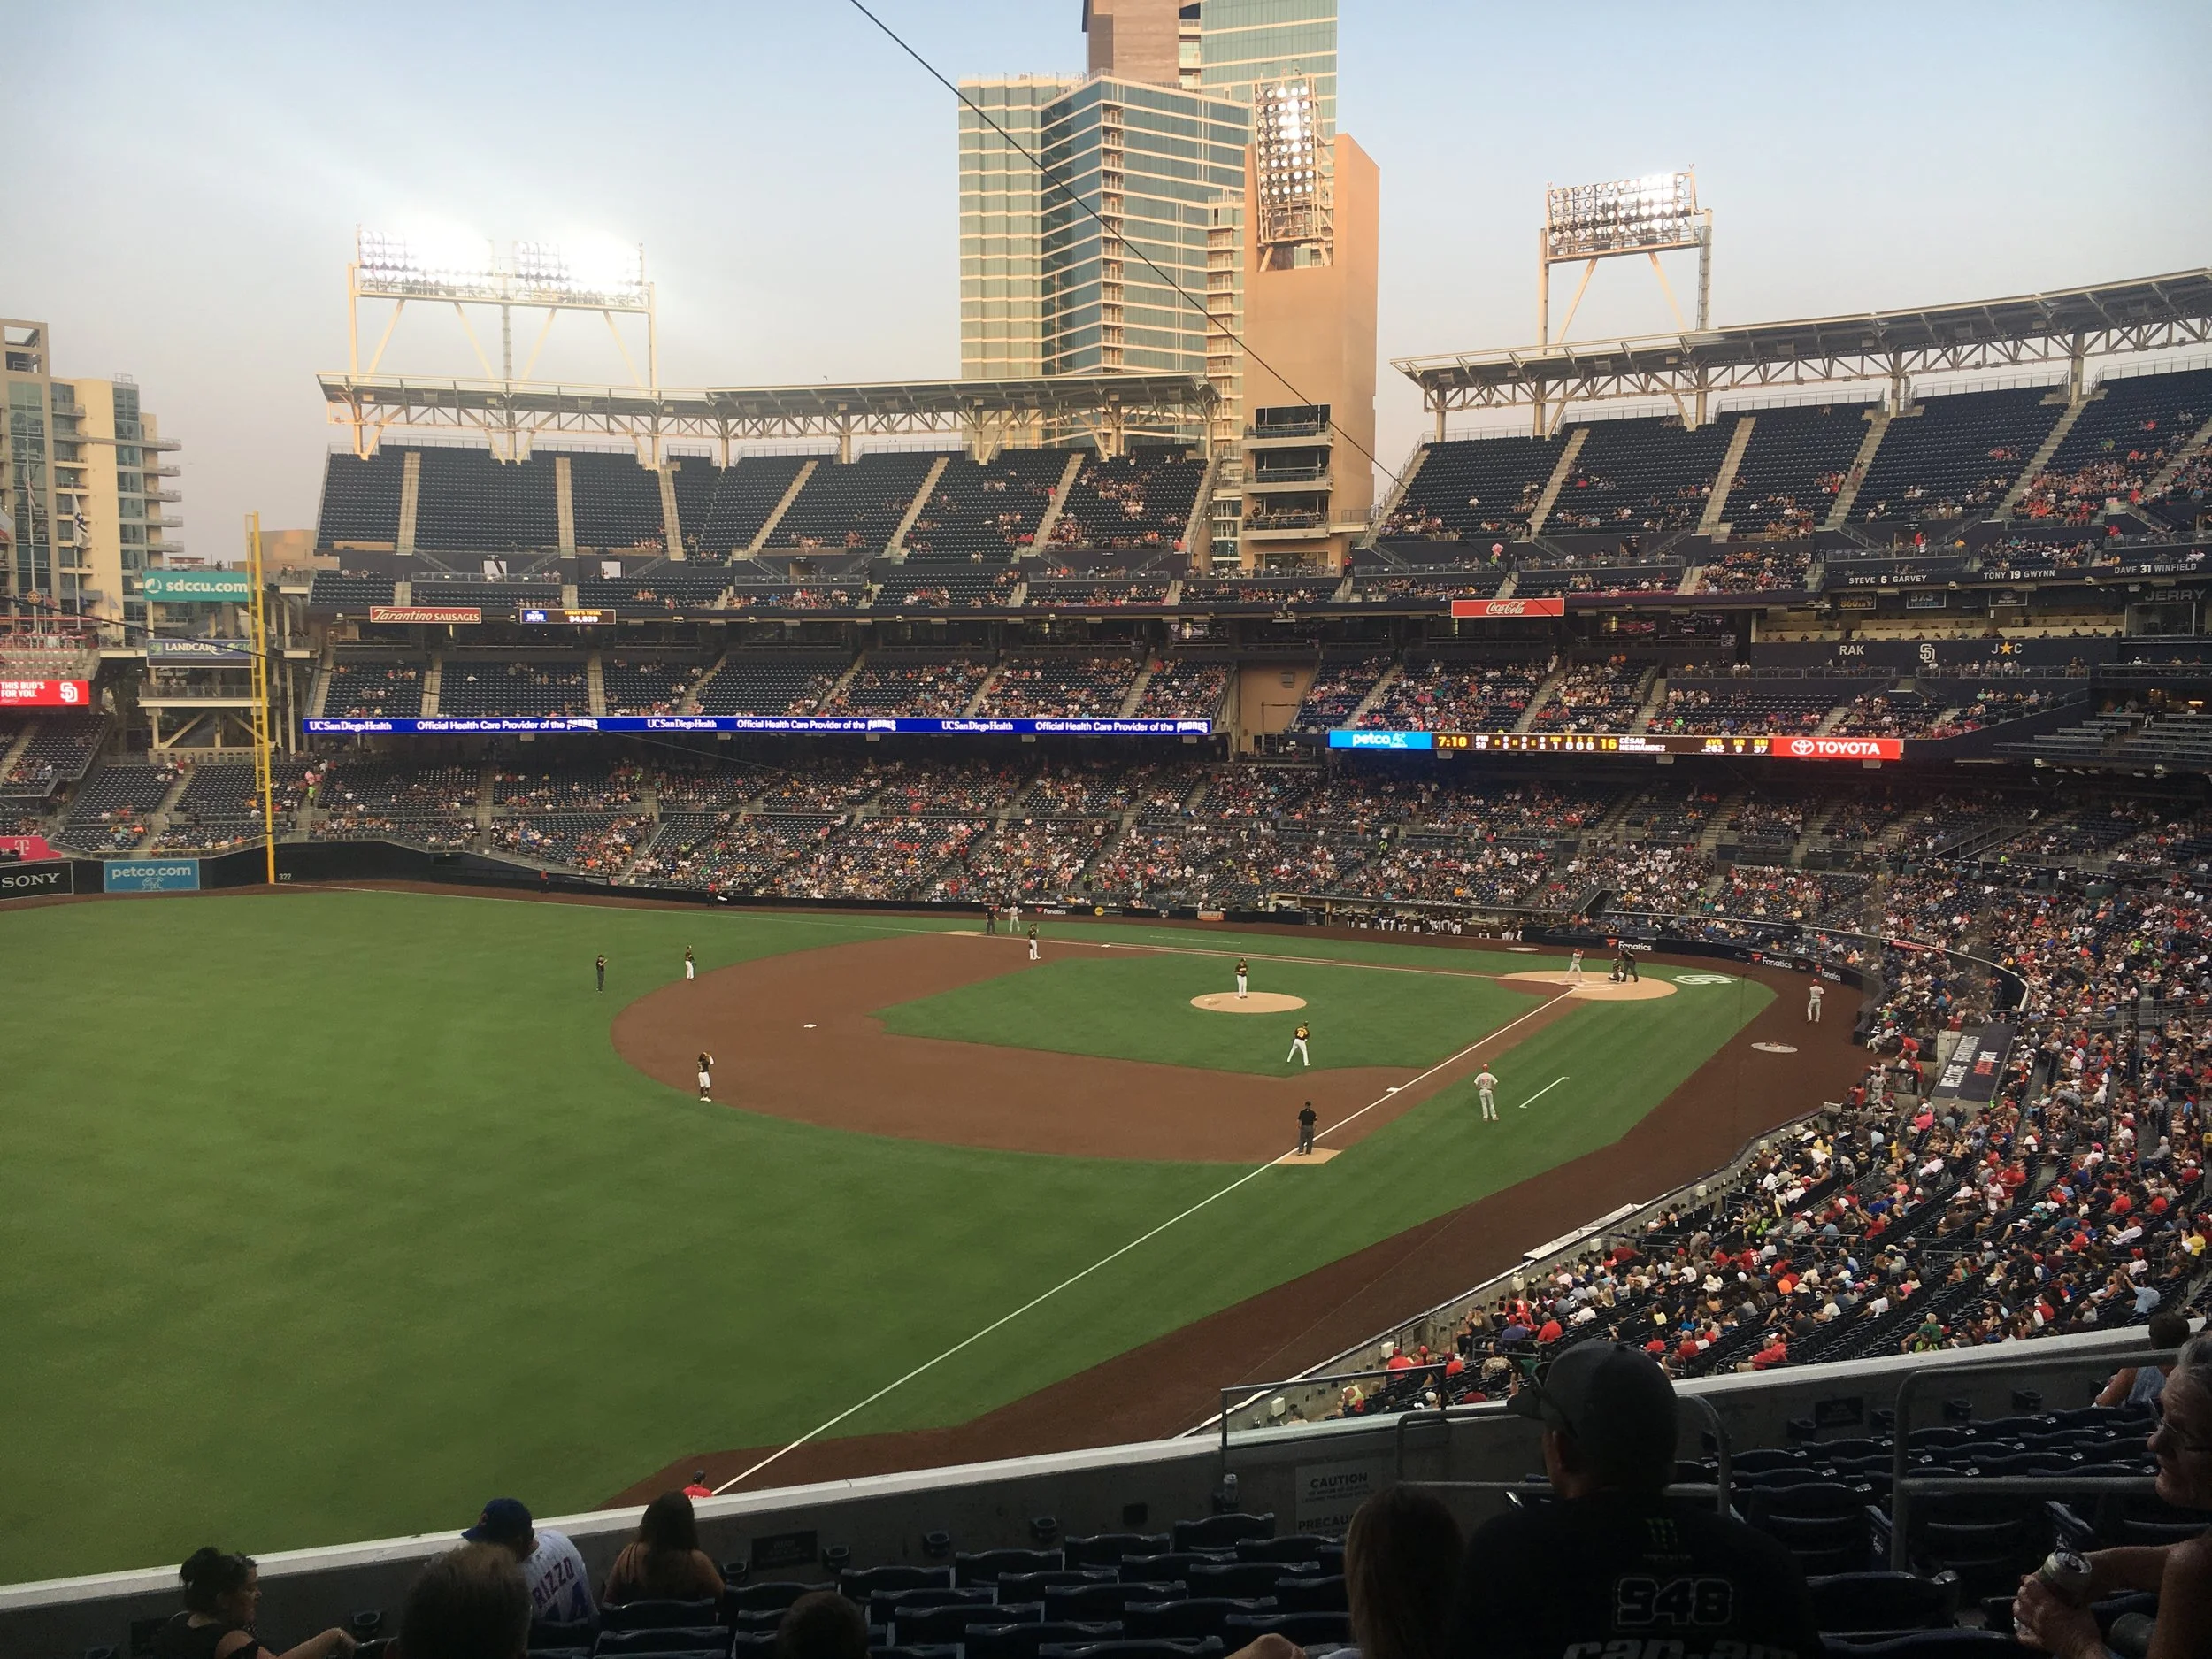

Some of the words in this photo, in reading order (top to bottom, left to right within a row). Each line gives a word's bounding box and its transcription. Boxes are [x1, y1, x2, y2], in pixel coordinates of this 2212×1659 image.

[2009, 570, 2021, 580] 19
[2114, 565, 2138, 574] DAVE
[2139, 565, 2152, 573] 31
[2154, 563, 2197, 572] WINFIELD
[166, 579, 248, 593] sdccu.com
[1880, 575, 1887, 584] 6
[2144, 589, 2206, 602] JERRY
[373, 609, 433, 621] Tarantino
[434, 613, 480, 622] SAUSAGES
[1839, 645, 1865, 656] RAK
[1920, 643, 1935, 664] SD
[60, 682, 79, 703] SD
[310, 721, 323, 730] UC
[324, 721, 341, 730] San
[342, 721, 365, 733] Diego
[365, 721, 392, 730] Health
[417, 721, 449, 730] Official
[451, 721, 479, 730] Health
[480, 721, 501, 730] Care
[503, 721, 538, 730] Provider
[567, 719, 598, 731] PADRES
[648, 719, 660, 728] UC
[660, 719, 674, 728] San
[675, 719, 695, 730] Diego
[695, 719, 717, 728] Health
[737, 719, 764, 729] Official
[766, 720, 789, 729] Health
[791, 720, 809, 729] Care
[810, 720, 841, 729] Provider
[843, 720, 852, 729] of
[852, 720, 865, 729] the
[867, 719, 896, 731] PADRES
[941, 721, 954, 730] UC
[955, 721, 969, 730] San
[969, 721, 989, 732] Diego
[989, 721, 1013, 730] Health
[1035, 721, 1064, 731] Official
[1065, 721, 1091, 731] Health
[1094, 722, 1112, 731] Care
[1114, 722, 1148, 732] Provider
[1149, 722, 1160, 732] of
[1160, 722, 1174, 732] the
[1177, 721, 1208, 733] PADRES
[1352, 733, 1390, 747] petco
[1438, 736, 1467, 747] 7:10
[1586, 742, 1594, 751] 0
[1601, 738, 1617, 749] 16
[1816, 741, 1881, 755] TOYOTA
[14, 839, 30, 856] T
[112, 864, 192, 879] petco.com
[2, 872, 61, 888] SONY
[1618, 941, 1653, 951] Fanatics
[1763, 956, 1793, 969] Fanatics
[1821, 968, 1841, 982] Fanatics
[1310, 1472, 1367, 1489] CAUTION
[532, 1557, 574, 1609] RIZZO
[1616, 1576, 1736, 1628] 948
